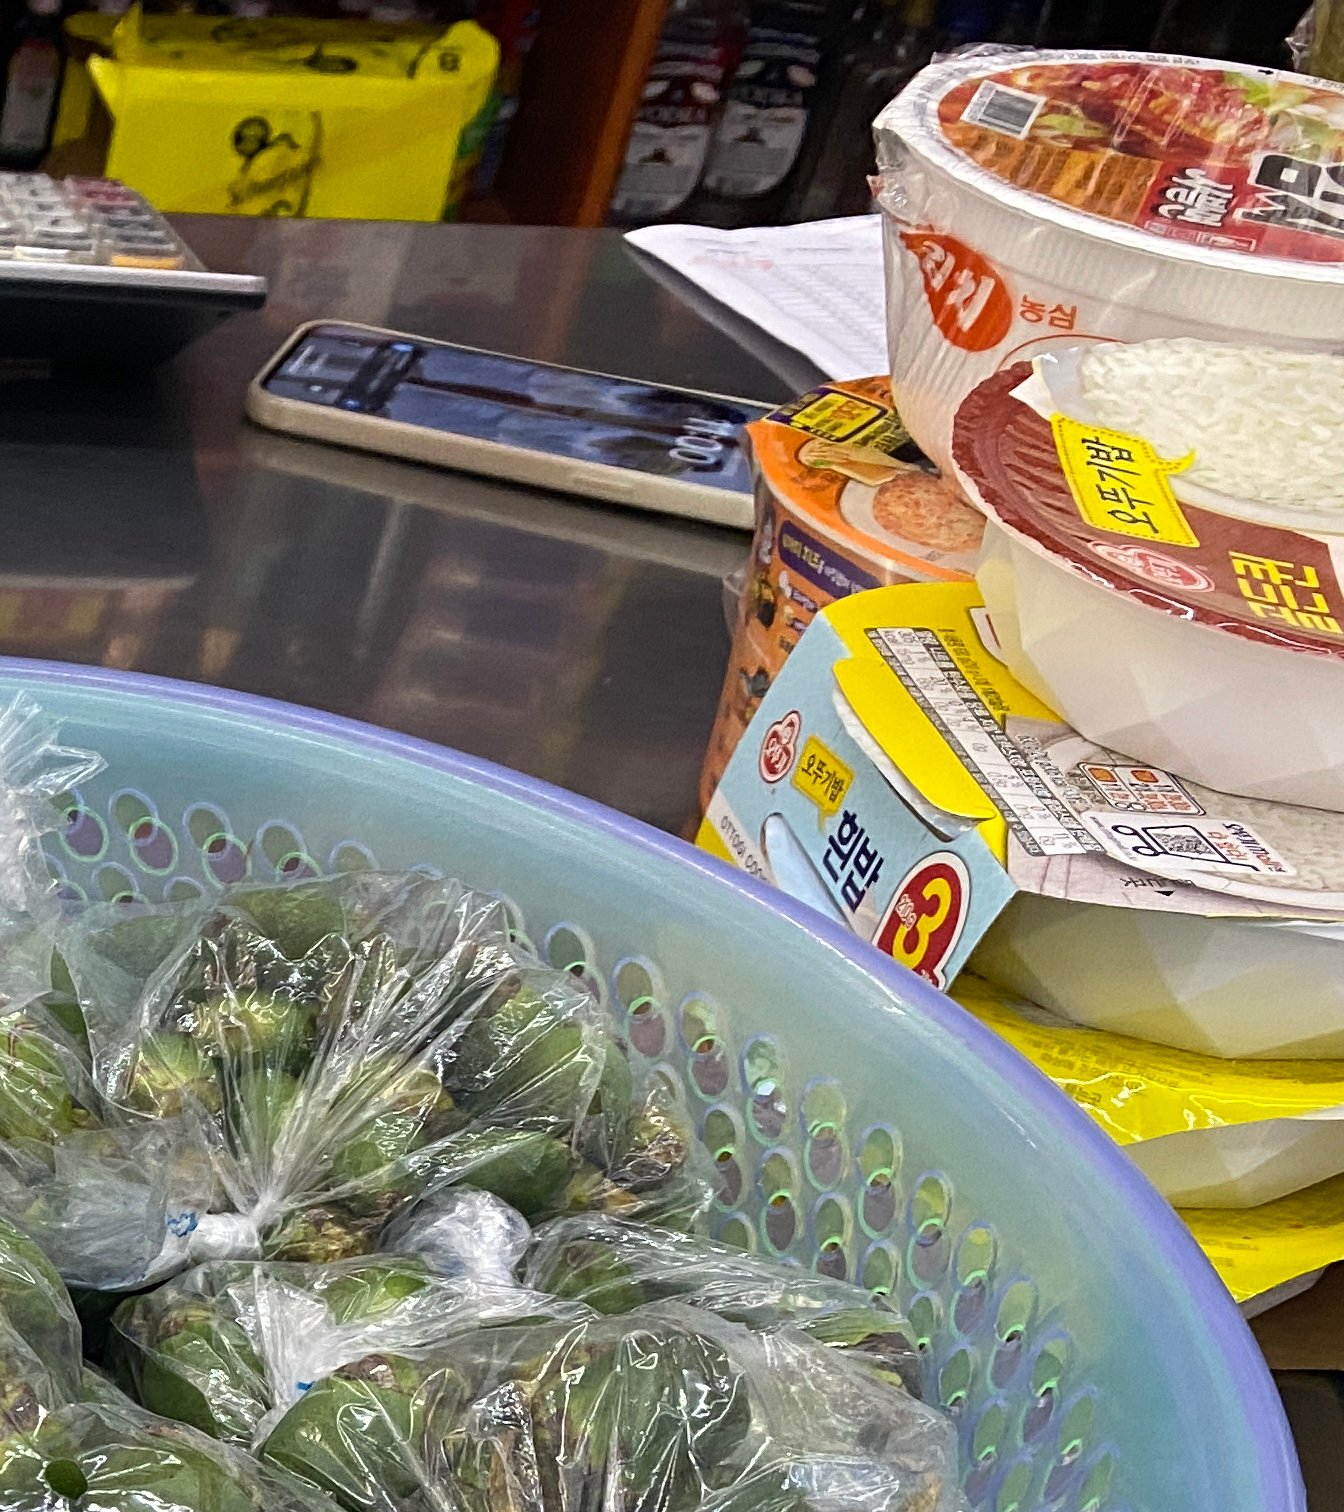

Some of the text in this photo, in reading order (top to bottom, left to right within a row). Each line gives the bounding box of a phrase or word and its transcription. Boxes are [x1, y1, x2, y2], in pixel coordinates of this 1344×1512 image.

[1020, 294, 1077, 330] 농심
[1081, 436, 1159, 535] 오뚜기밥
[801, 753, 846, 803] 오뚜기밥
[822, 810, 884, 913] 흰밥
[892, 877, 952, 970] 3
